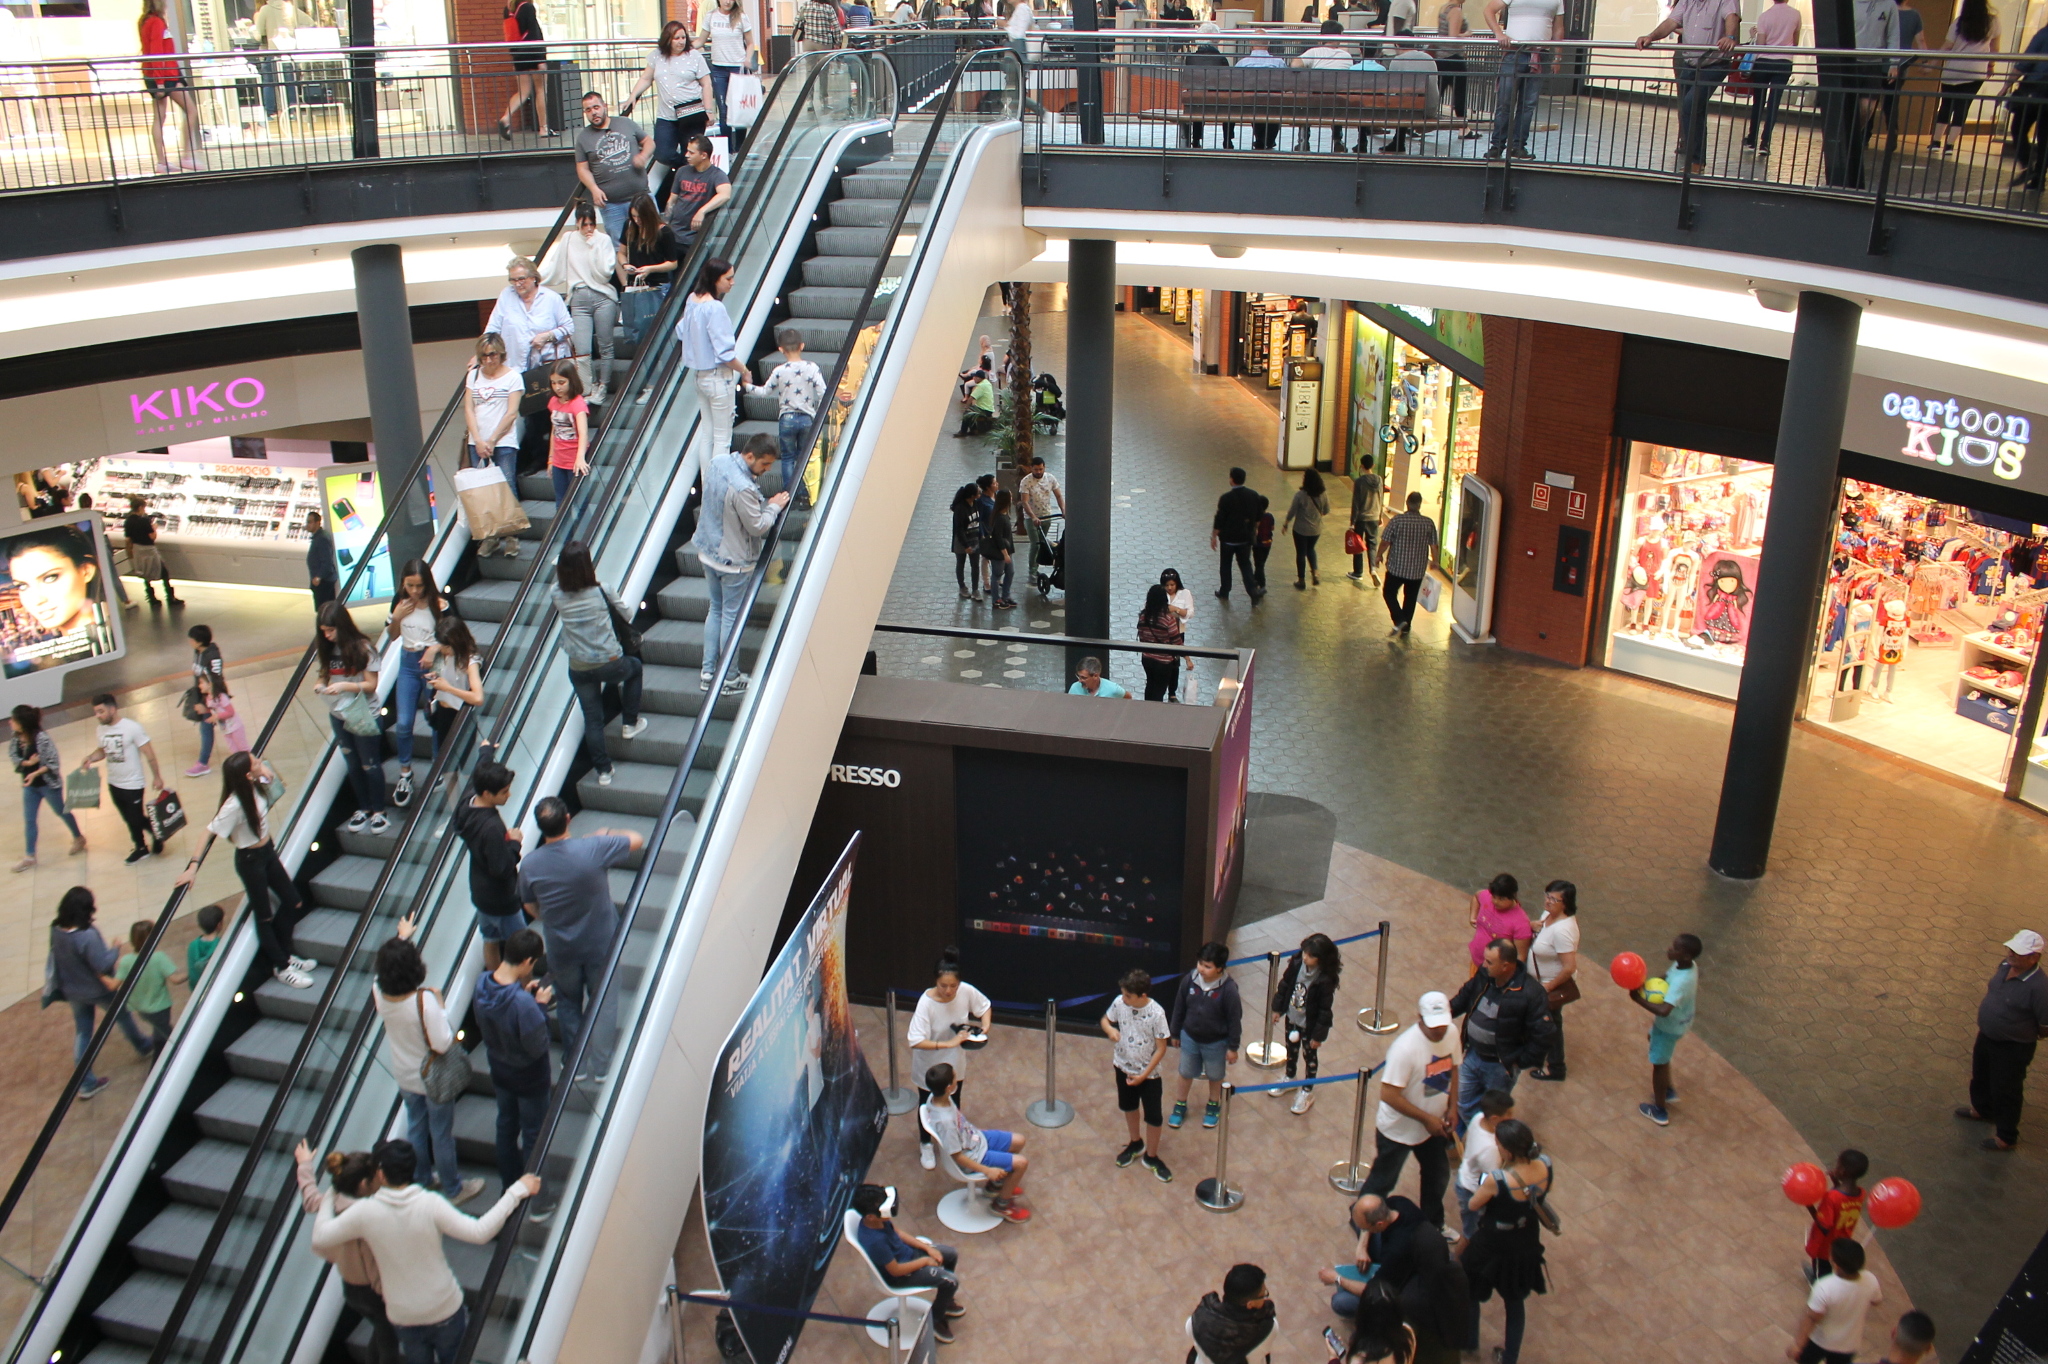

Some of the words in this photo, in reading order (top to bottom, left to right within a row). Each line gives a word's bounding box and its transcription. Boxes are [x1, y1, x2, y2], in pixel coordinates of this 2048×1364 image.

[130, 377, 265, 424] KIKO
[136, 424, 176, 435] MAKE
[185, 420, 203, 428] UP
[213, 410, 268, 424] MILANO
[1882, 391, 2030, 444] cartoon
[1901, 420, 2026, 480] KIDS
[831, 764, 902, 788] RESSO
[806, 861, 853, 959] VIRTUAL
